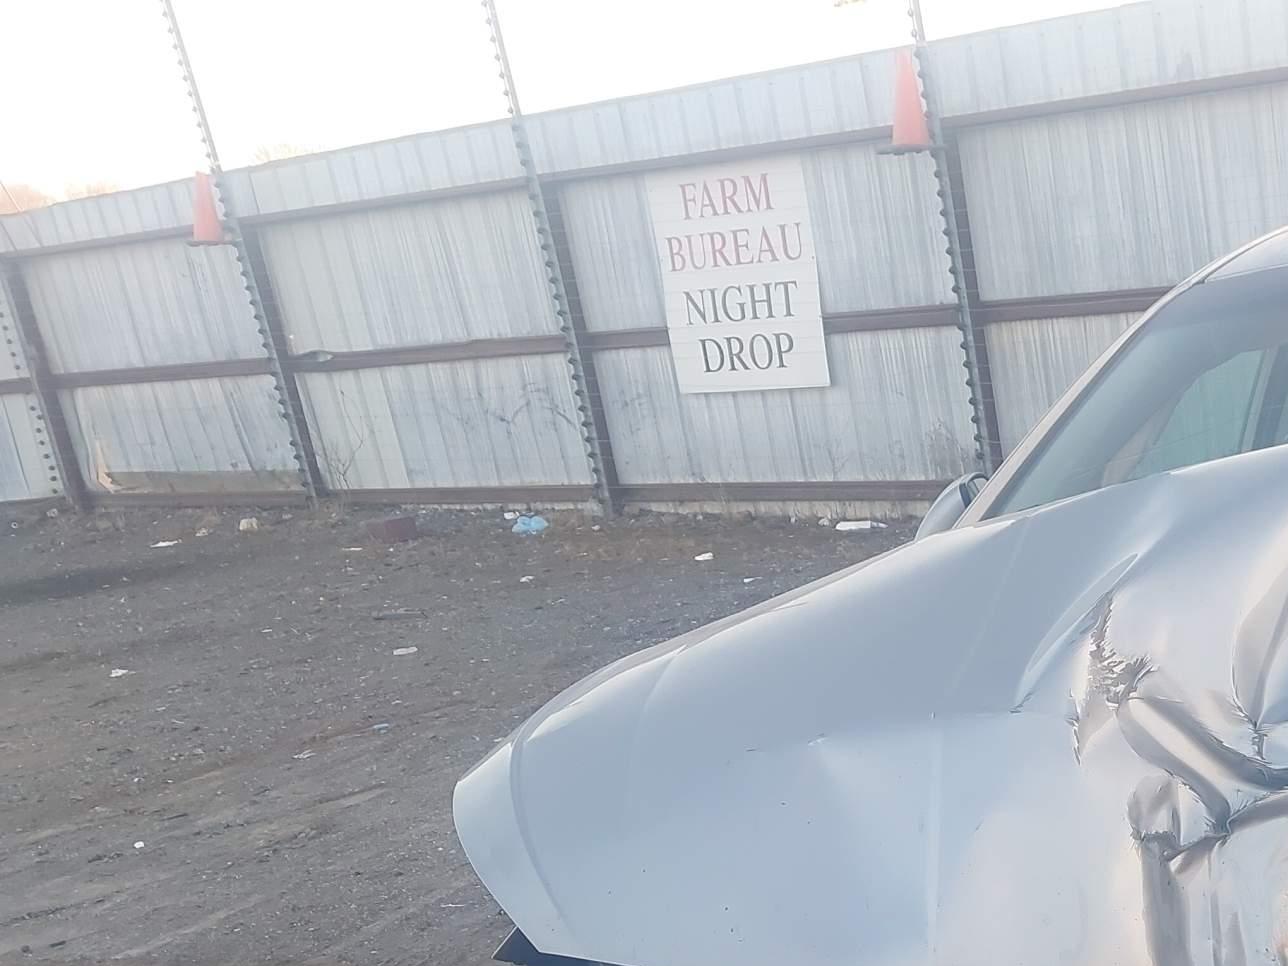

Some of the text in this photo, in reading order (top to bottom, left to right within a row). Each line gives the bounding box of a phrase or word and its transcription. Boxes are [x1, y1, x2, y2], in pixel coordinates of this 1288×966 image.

[679, 172, 775, 221] FARM
[665, 221, 802, 273] BUREAU
[683, 280, 798, 326] NIGHT
[699, 331, 795, 374] DROP
